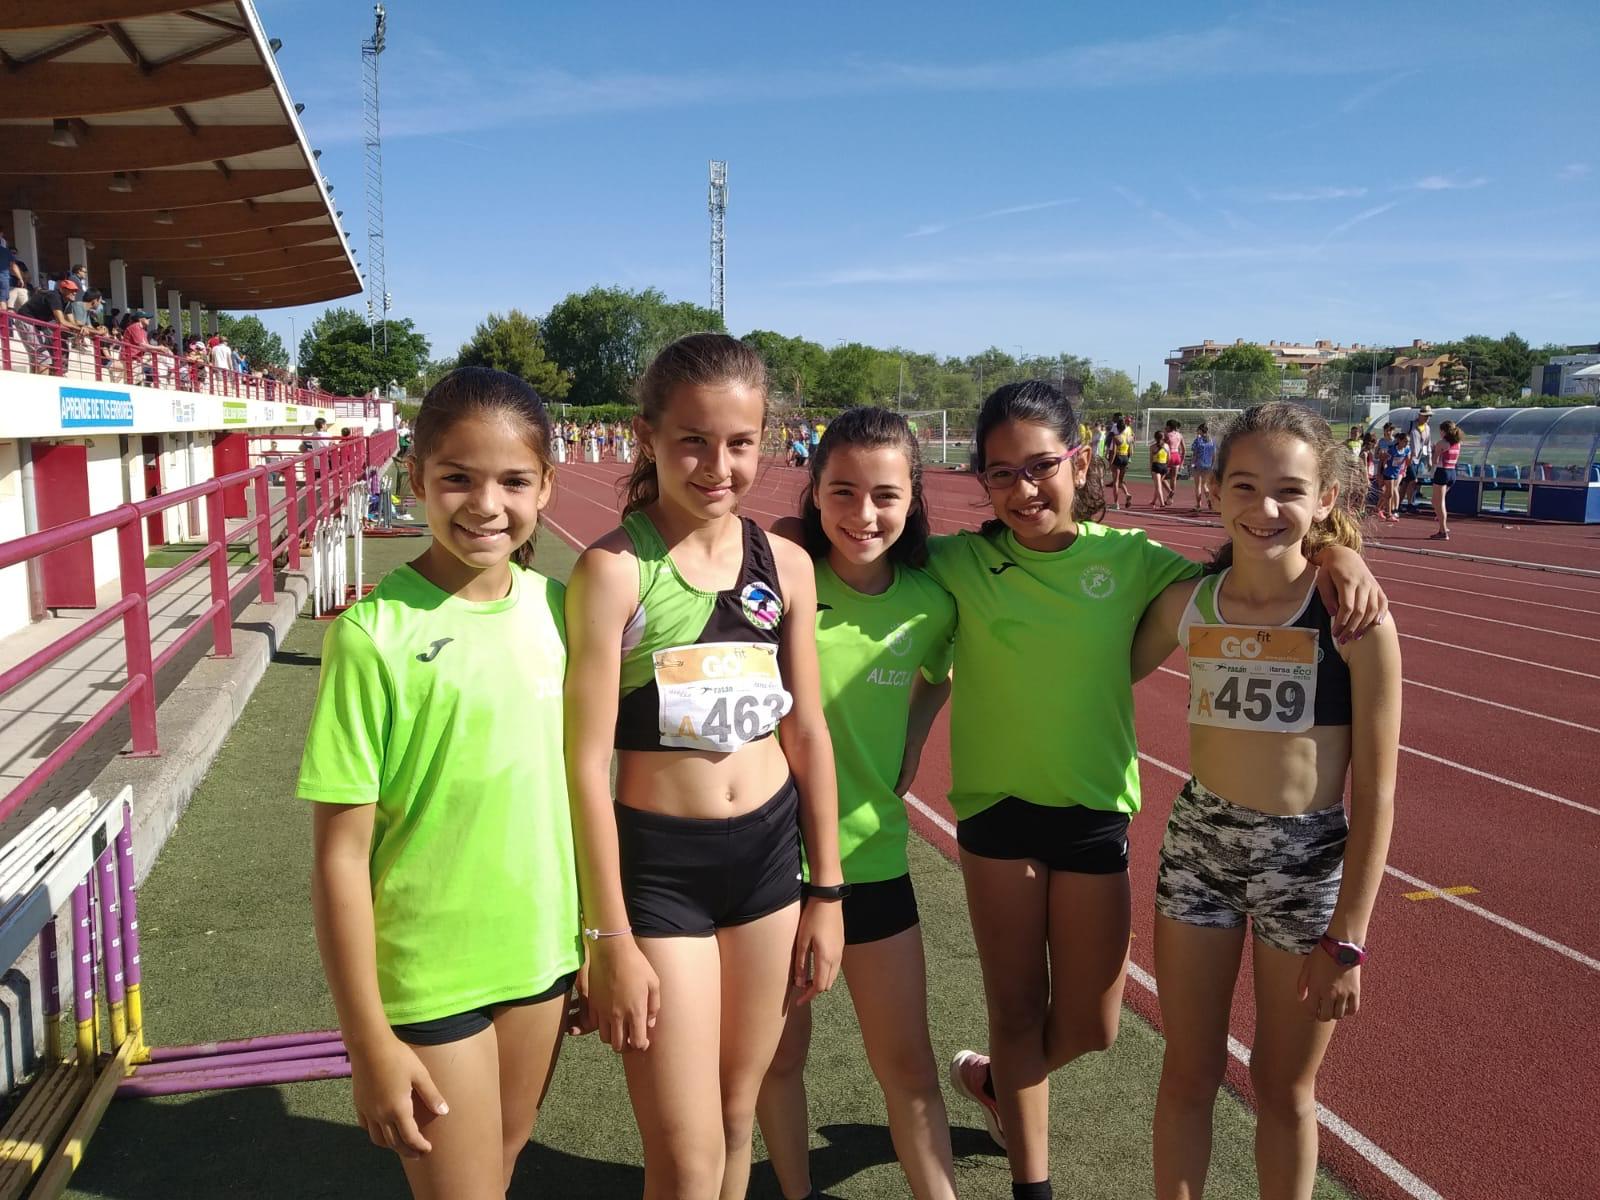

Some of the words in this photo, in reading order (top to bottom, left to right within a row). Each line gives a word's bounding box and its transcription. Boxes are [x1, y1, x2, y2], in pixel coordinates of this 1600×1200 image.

[61, 397, 92, 419] APRENDE
[92, 399, 100, 420] DE
[100, 399, 111, 420] TUS
[110, 400, 133, 420] ERRORES
[1221, 636, 1262, 658] GO
[1256, 630, 1272, 643] fit
[1214, 676, 1306, 723] 459
[678, 715, 698, 741] A
